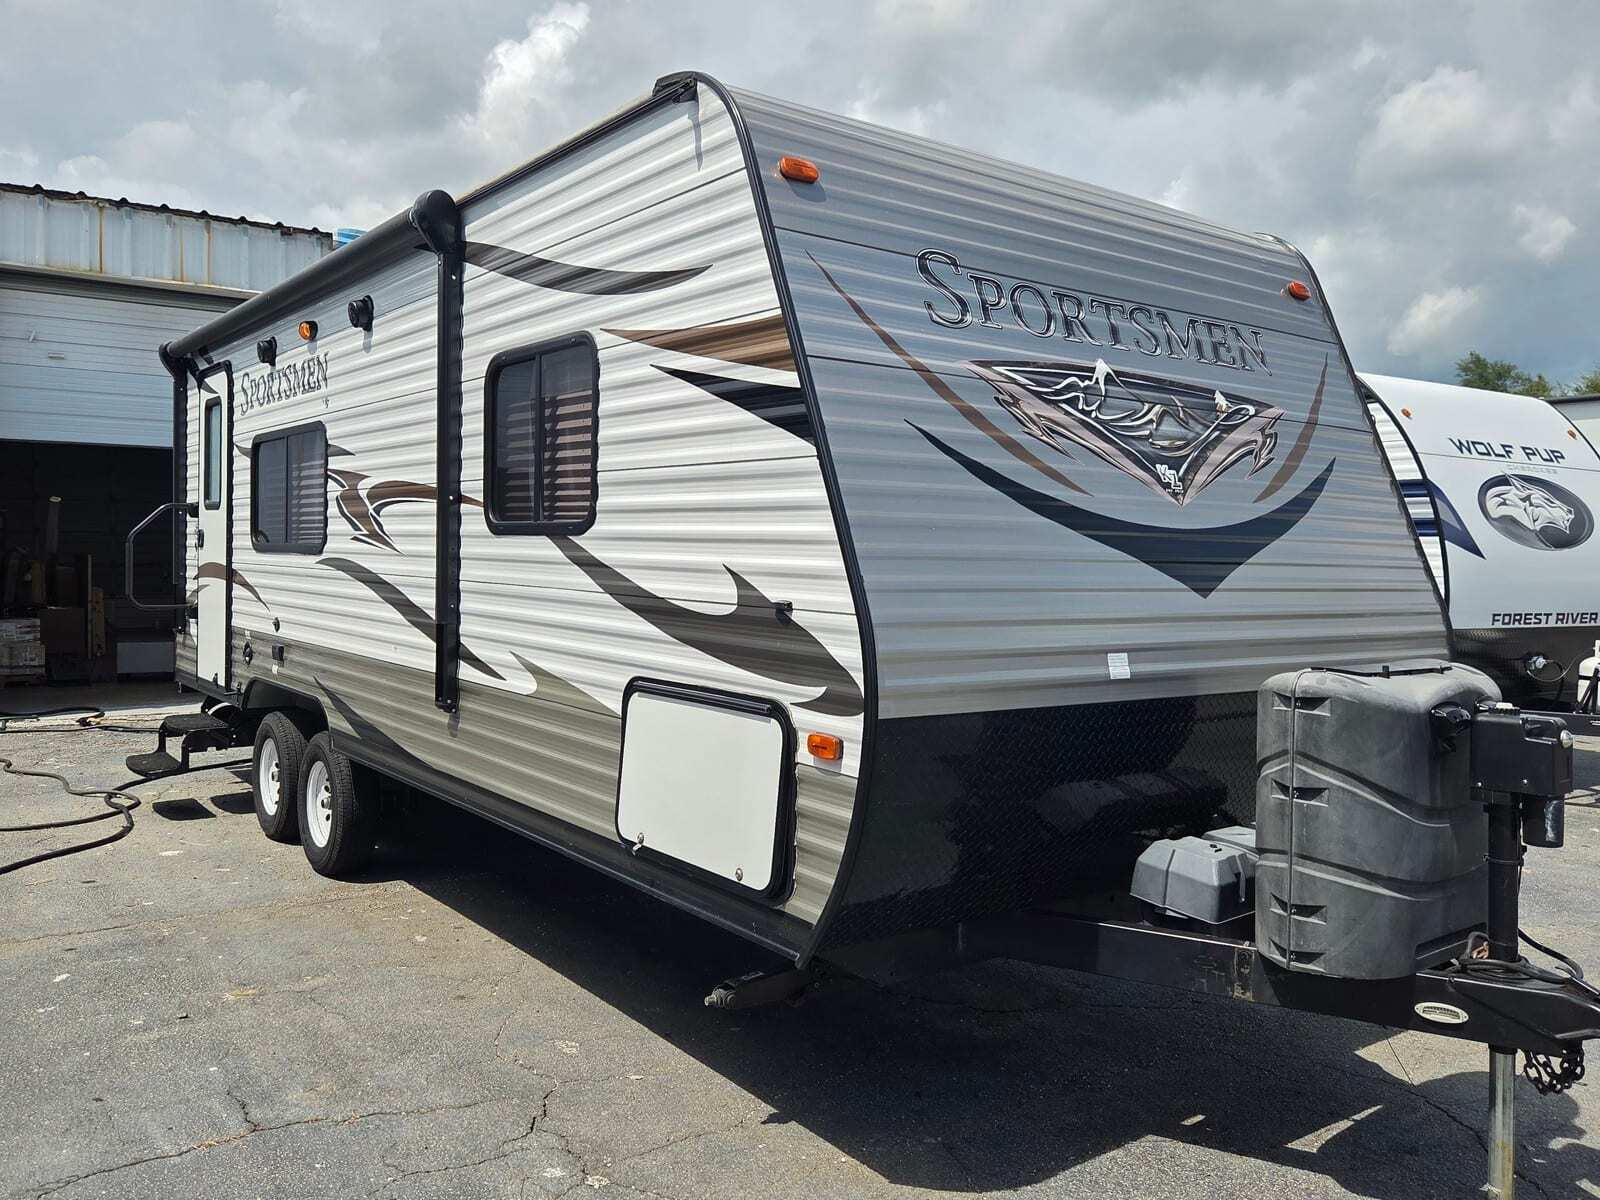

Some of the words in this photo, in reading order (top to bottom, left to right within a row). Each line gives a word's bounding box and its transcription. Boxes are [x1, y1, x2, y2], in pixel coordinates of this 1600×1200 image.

[915, 248, 1272, 376] SPORTSMEN
[240, 352, 329, 415] SPORTSMEN
[1448, 438, 1514, 459] WOLF
[1521, 446, 1566, 464] PUP
[1492, 613, 1552, 625] FOREST
[1555, 612, 1598, 624] RIVER
